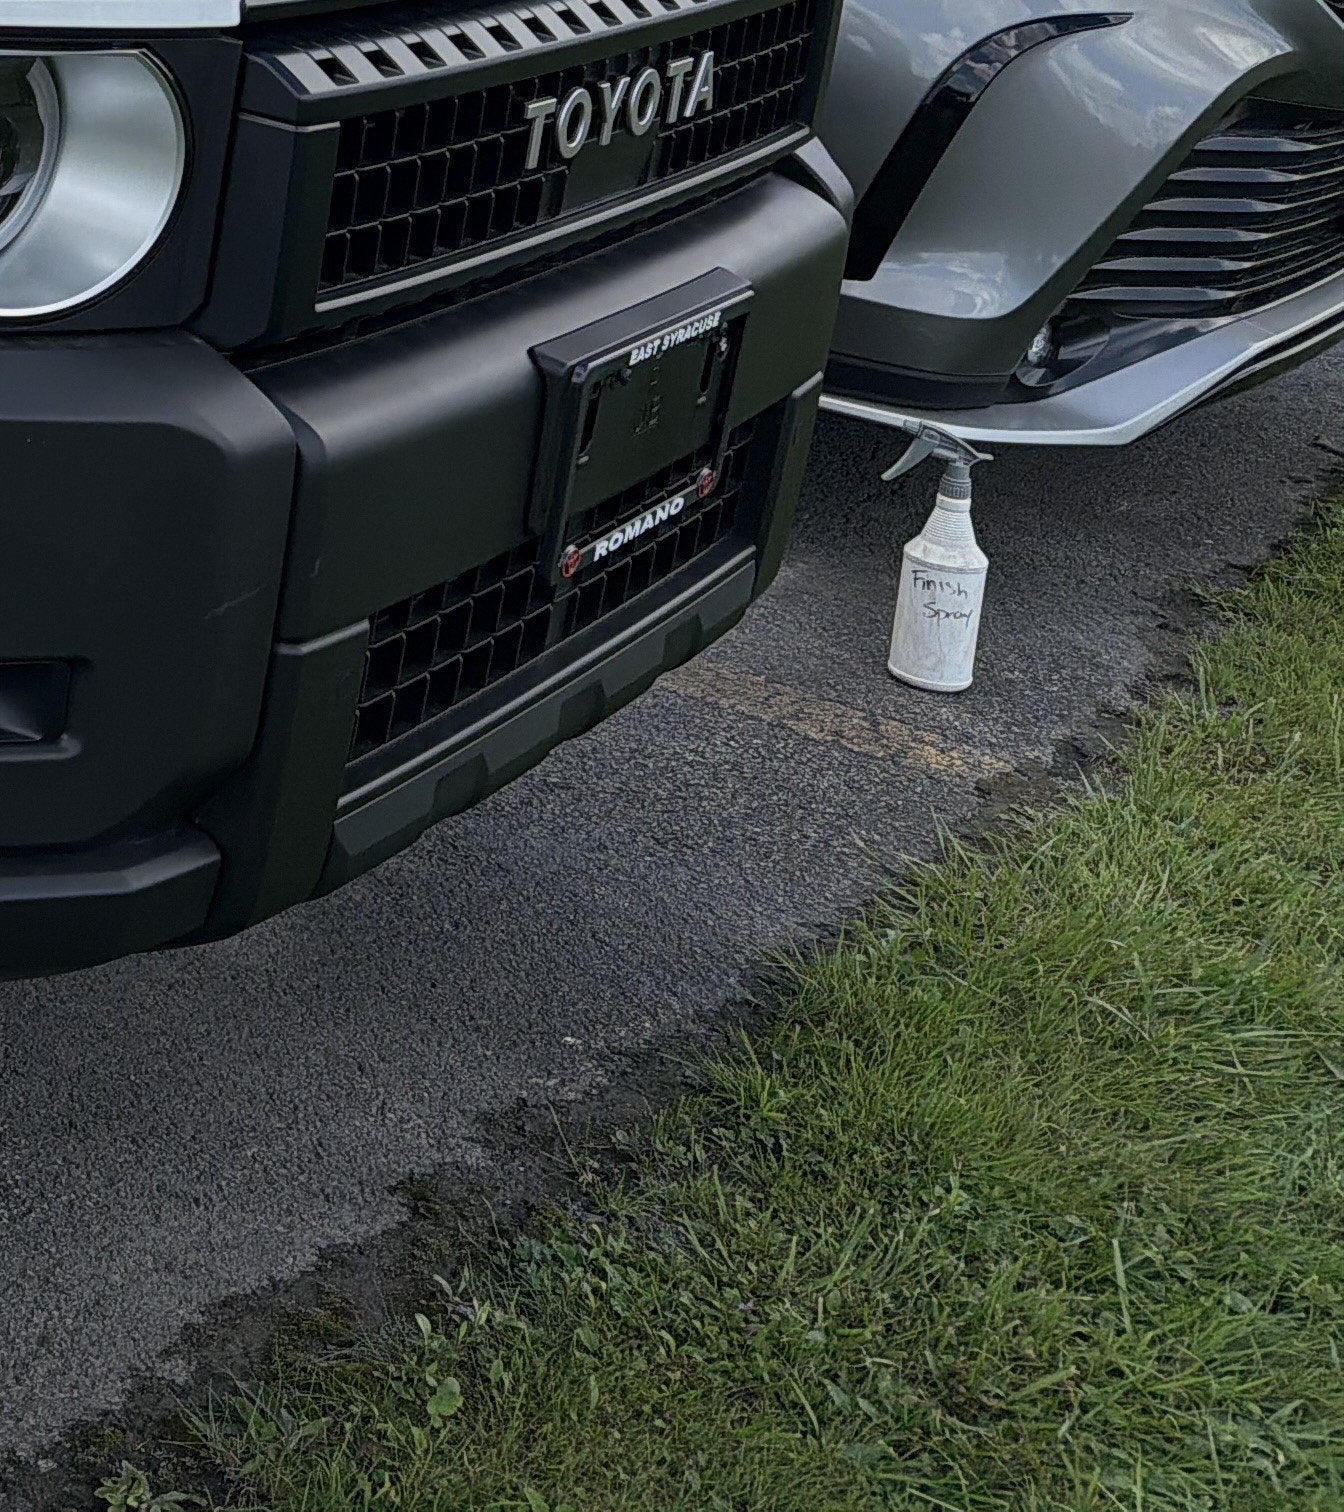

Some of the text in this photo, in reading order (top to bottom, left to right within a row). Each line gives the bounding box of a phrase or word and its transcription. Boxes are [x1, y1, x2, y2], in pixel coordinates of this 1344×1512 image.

[524, 50, 714, 170] TOYOTA
[628, 311, 722, 366] EAST SYRACUSE
[593, 497, 685, 562] ROMANO
[911, 568, 968, 600] Finish
